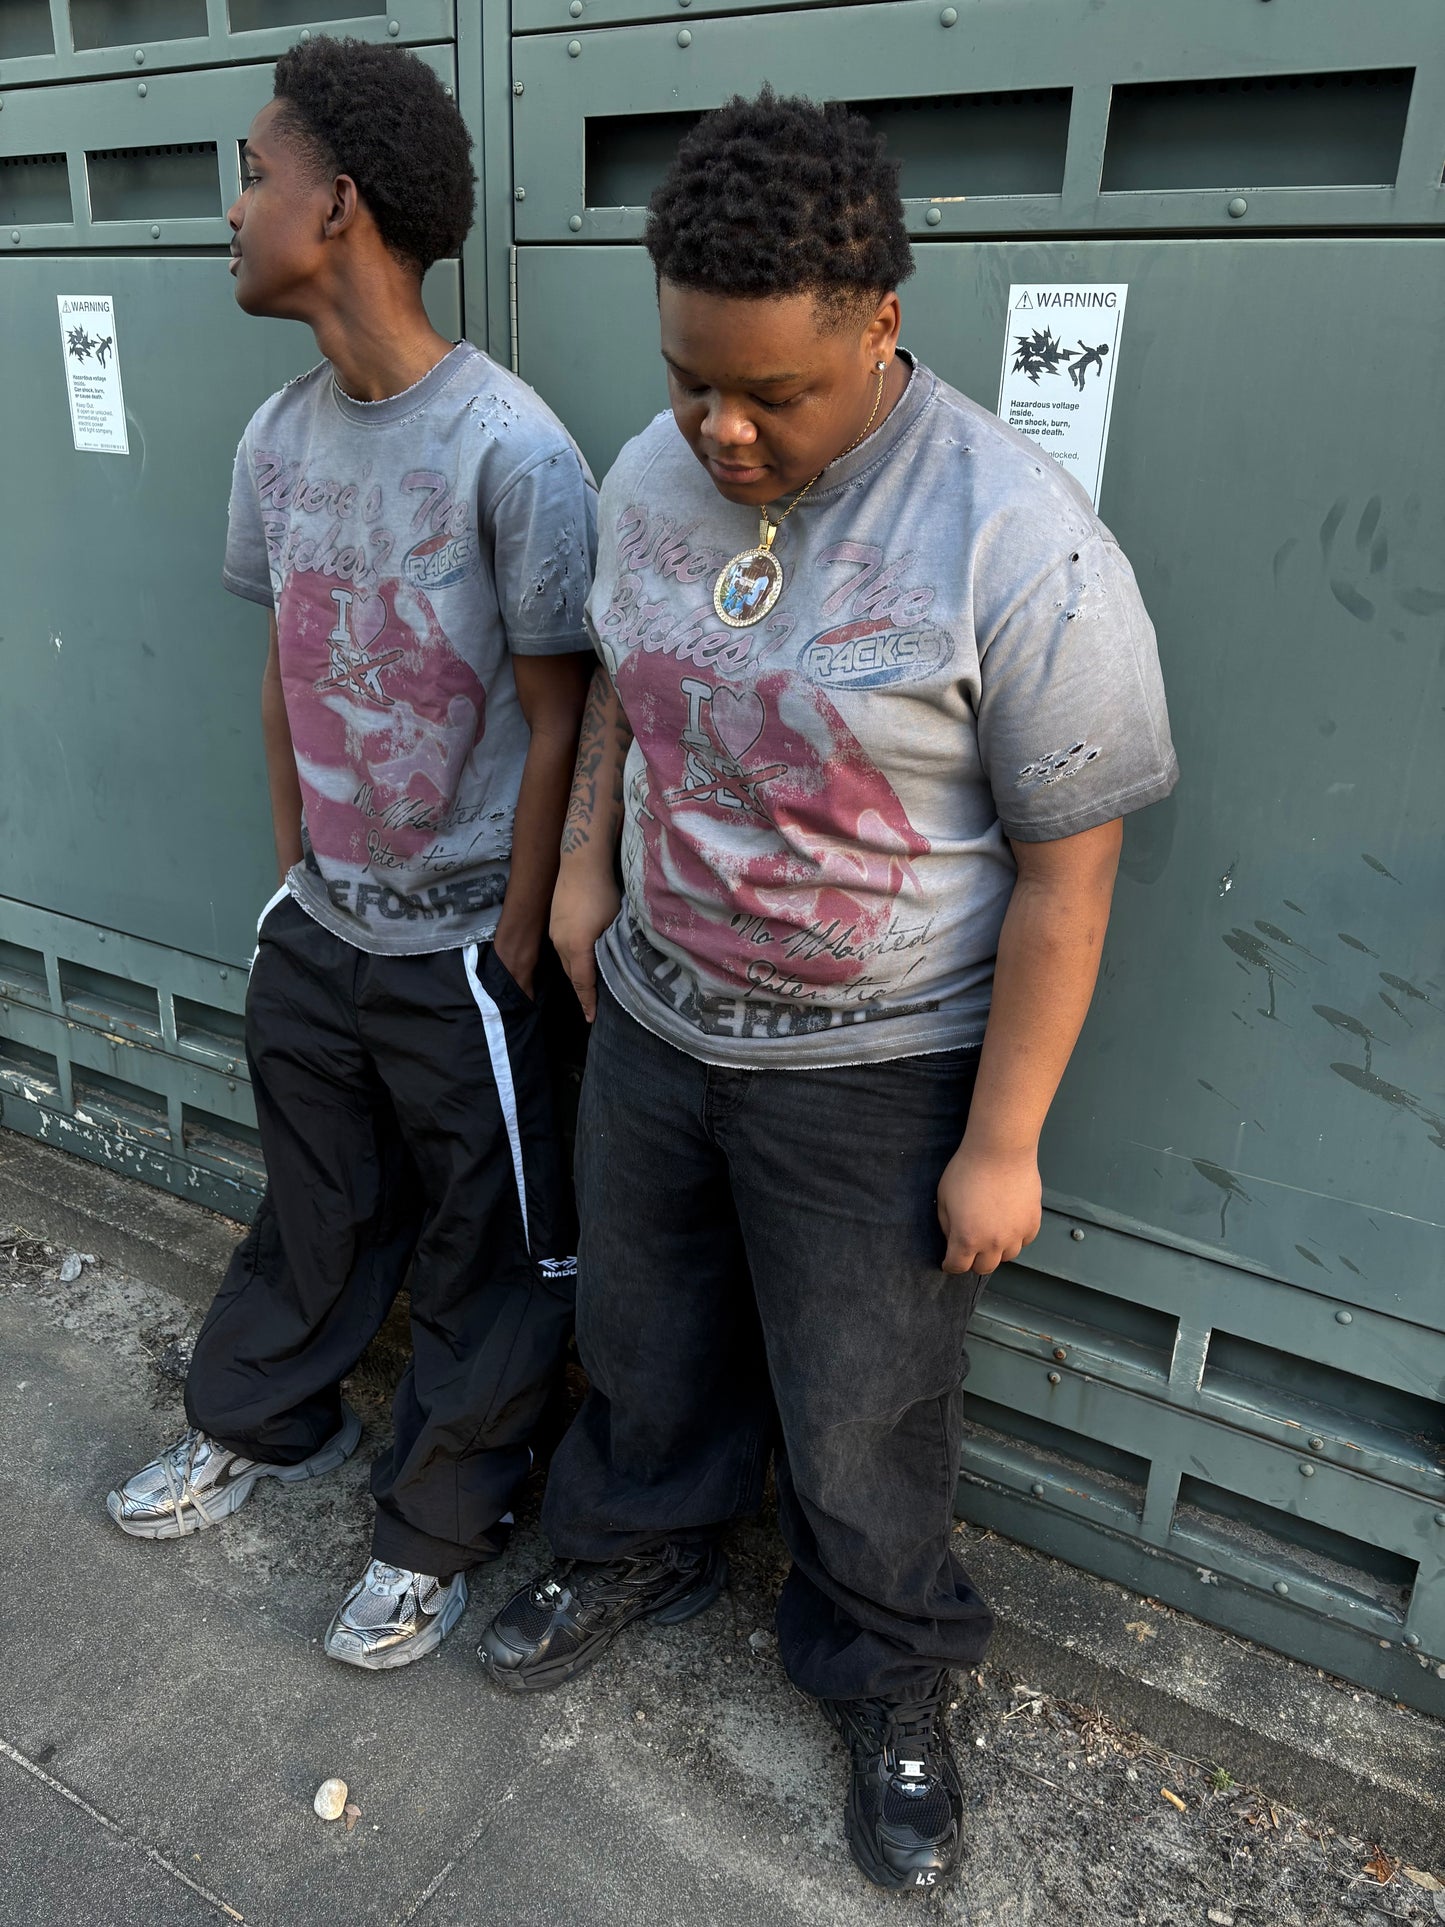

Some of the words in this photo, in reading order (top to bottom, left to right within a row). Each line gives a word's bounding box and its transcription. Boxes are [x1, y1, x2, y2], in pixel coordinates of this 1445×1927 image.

[1036, 292, 1117, 308] WARNING
[71, 301, 110, 312] WARNING
[1010, 400, 1050, 408] Hazardous
[1052, 401, 1080, 411] voltage
[1009, 409, 1034, 417] inside.
[1009, 417, 1023, 425] Can
[1024, 418, 1049, 427] shock,
[1051, 419, 1071, 428] burn,
[1041, 428, 1065, 436] death.
[400, 471, 468, 537] The
[815, 540, 935, 627] The
[915, 1872, 936, 1886] 45
